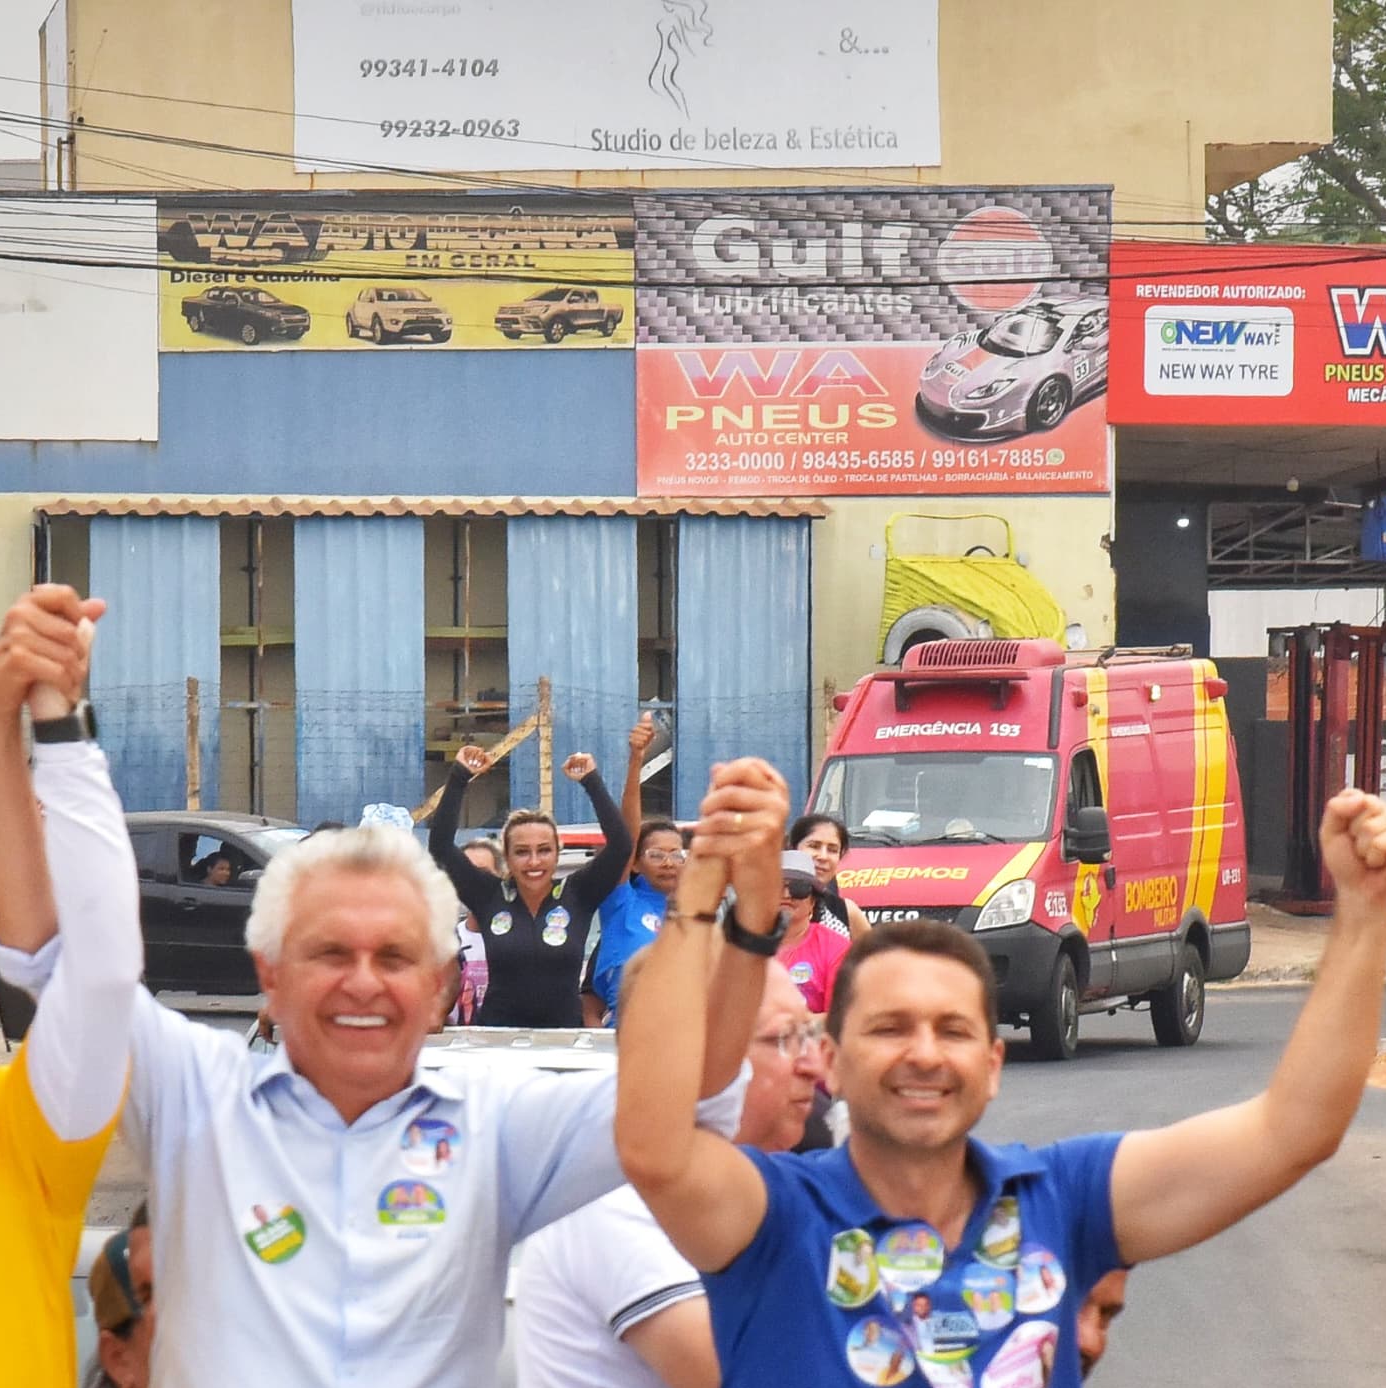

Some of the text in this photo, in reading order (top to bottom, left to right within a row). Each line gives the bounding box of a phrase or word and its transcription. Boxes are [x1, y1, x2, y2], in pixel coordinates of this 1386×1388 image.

[359, 58, 500, 79] 99341-4104
[380, 118, 521, 140] 99232-0963
[590, 124, 899, 153] Studio de beleza & Estética
[692, 213, 919, 278] Gulf
[405, 253, 537, 268] EM GERAL
[170, 270, 229, 284] Diesel
[1136, 284, 1307, 299] REVENDEDOR AUTORIZADO:
[674, 350, 890, 399] WA
[1159, 363, 1280, 380] NEW WAY TYRE
[1324, 363, 1385, 383] PNEUS
[665, 403, 899, 431] PNEUS
[716, 431, 850, 446] AUTO CENTER
[685, 452, 785, 471] 3233-0000
[802, 450, 915, 470] 98435-6585
[932, 448, 1045, 468] 99161-7885
[875, 720, 1022, 740] EMERGÊNCIA 193
[1124, 874, 1179, 914] BOMBEIRO
[862, 910, 920, 924] VECO
